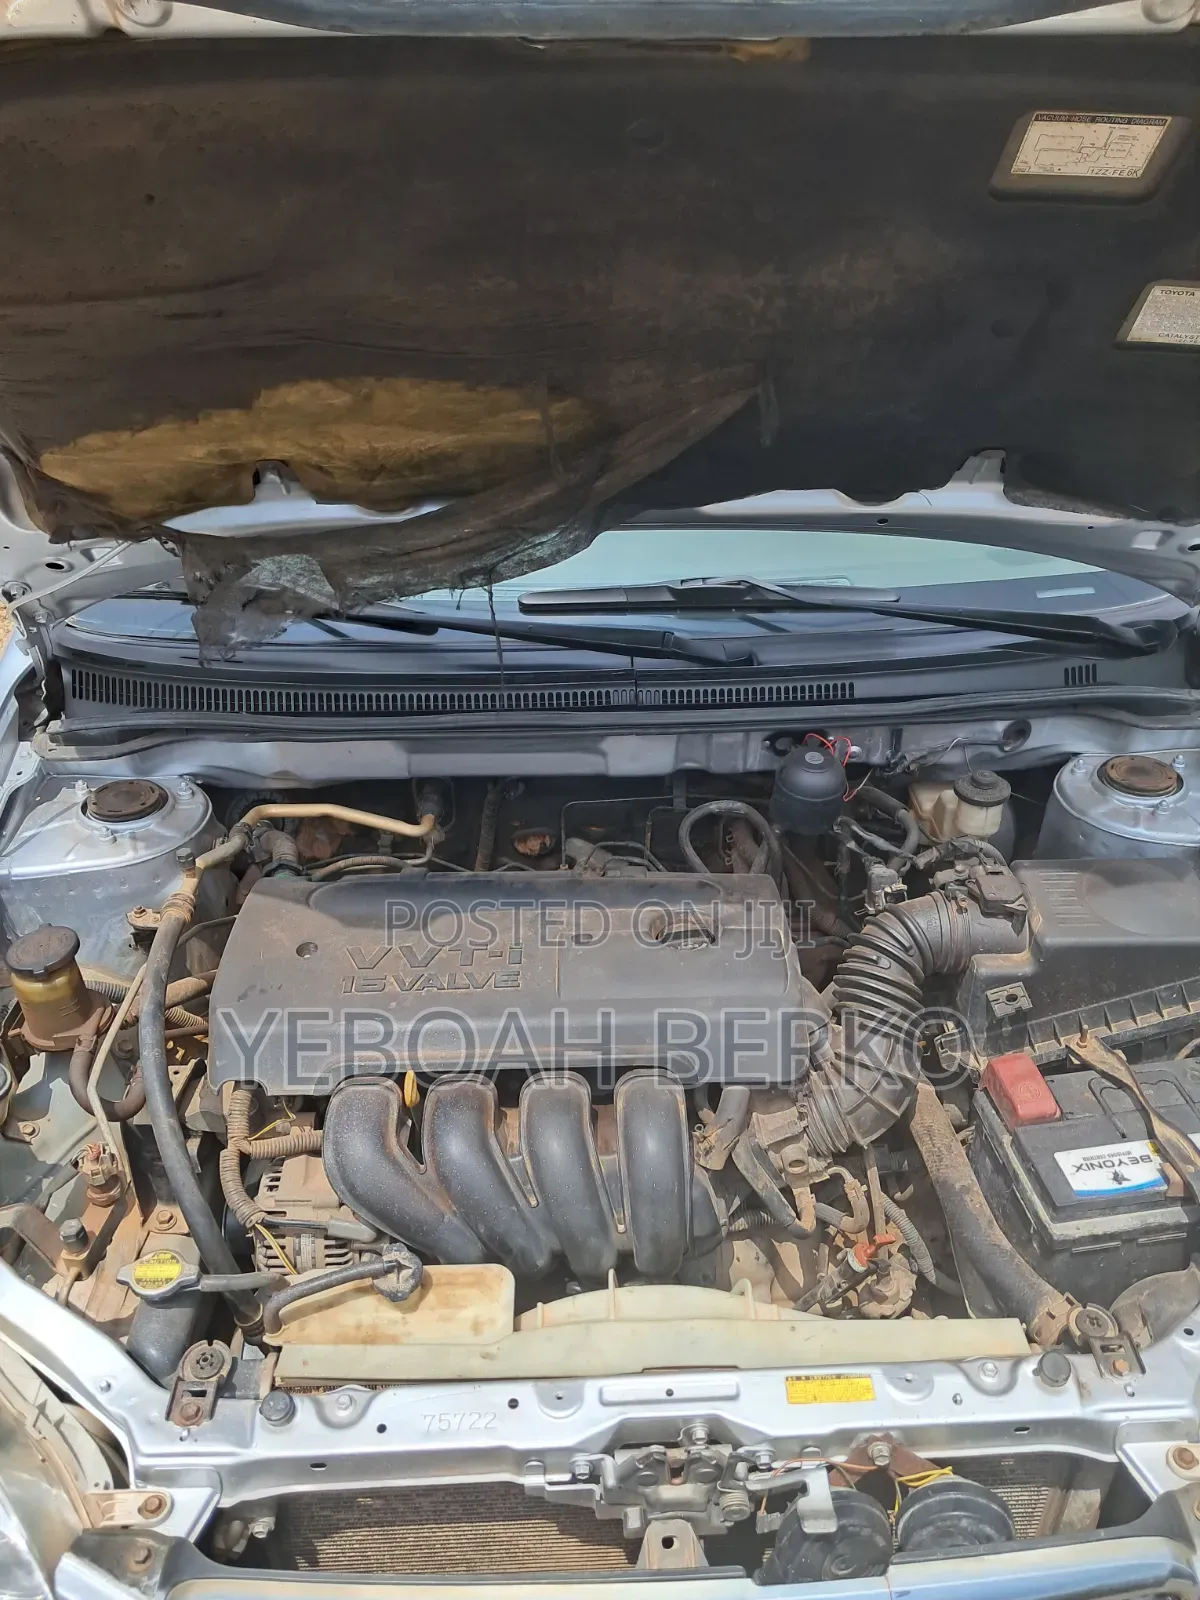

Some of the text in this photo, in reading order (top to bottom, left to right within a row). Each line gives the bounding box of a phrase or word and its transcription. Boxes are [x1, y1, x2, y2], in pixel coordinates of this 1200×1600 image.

[1038, 113, 1165, 126] VACUUM HOSE ROUTING DIAGRAM
[1160, 289, 1195, 297] TOYOTA
[1158, 332, 1200, 340] CATALYST
[1072, 1154, 1153, 1173] BEYONIX
[421, 1411, 497, 1433] 75722
